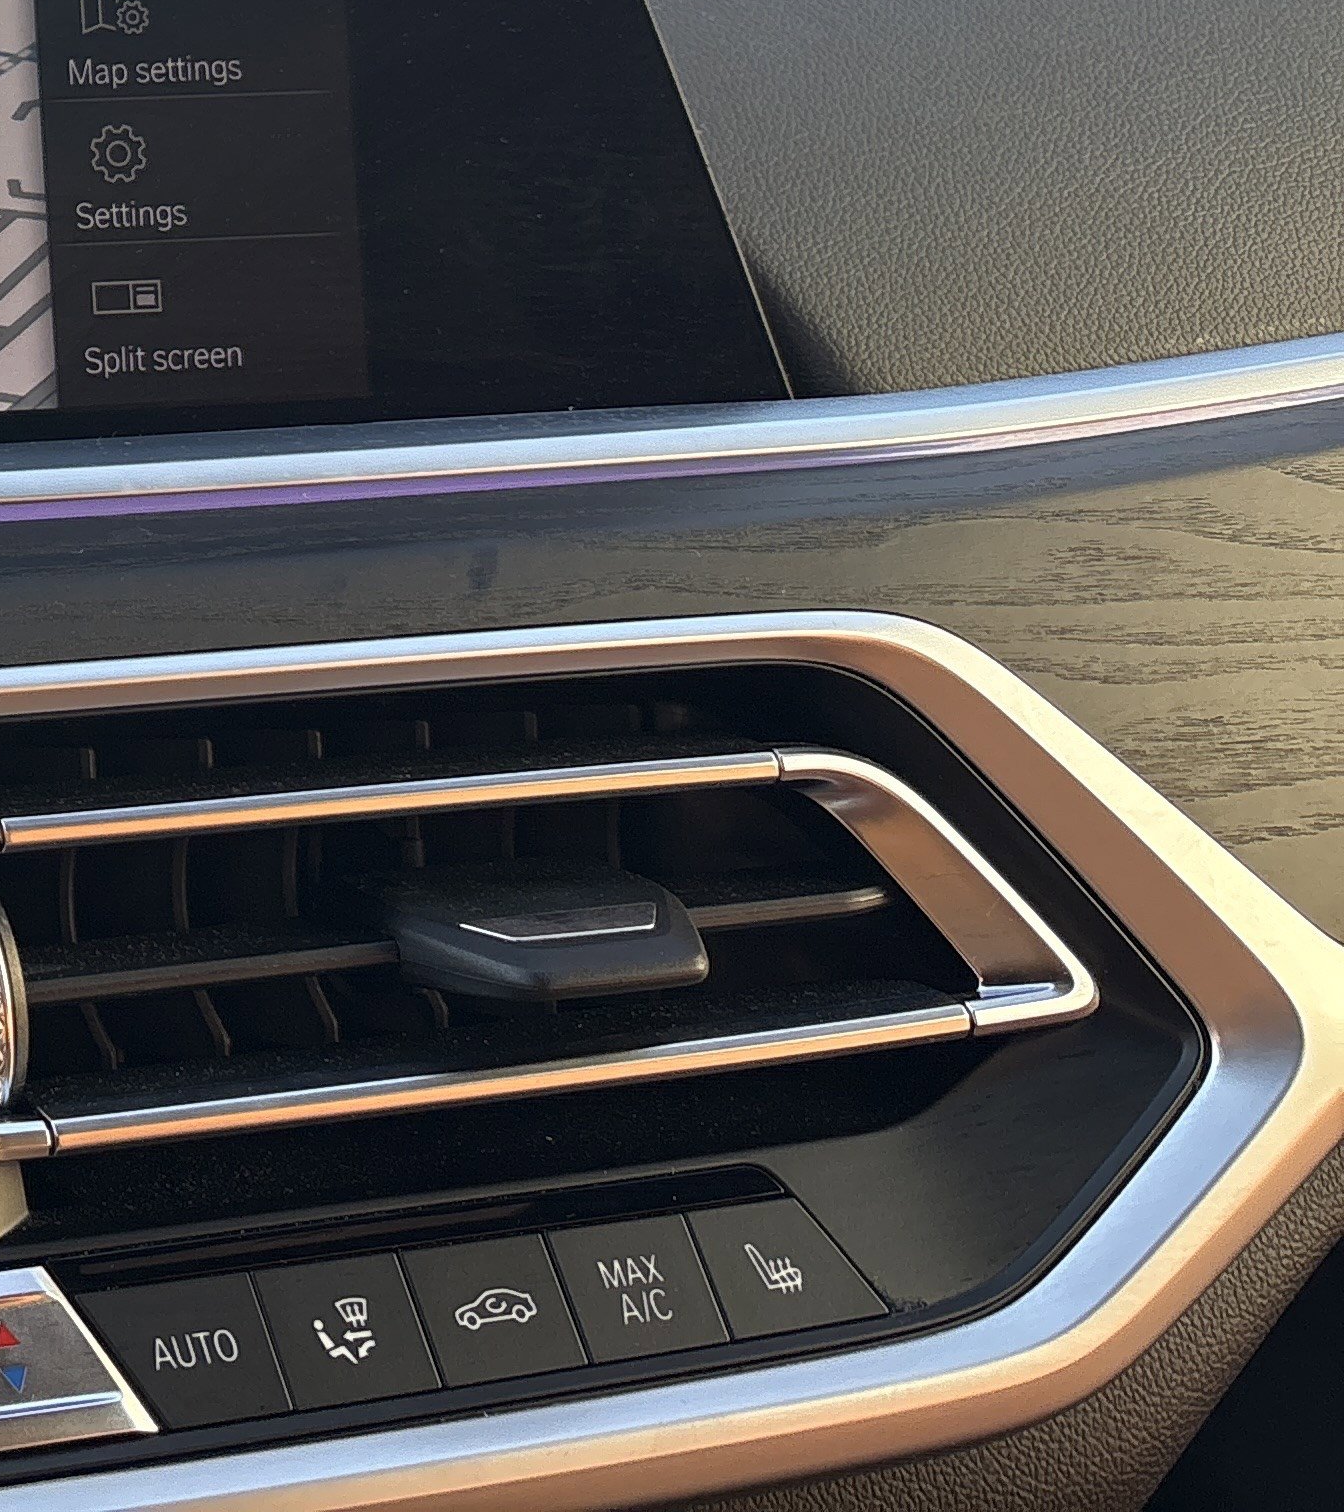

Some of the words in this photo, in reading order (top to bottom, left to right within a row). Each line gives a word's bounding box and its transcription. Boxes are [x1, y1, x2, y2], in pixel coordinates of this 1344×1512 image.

[66, 58, 130, 89] Map
[134, 56, 244, 85] settings
[74, 201, 189, 231] Settings
[83, 345, 148, 376] Split
[152, 344, 244, 372] screen
[597, 1254, 663, 1288] MAX
[620, 1289, 675, 1325] A/C
[152, 1329, 240, 1371] AUTO
